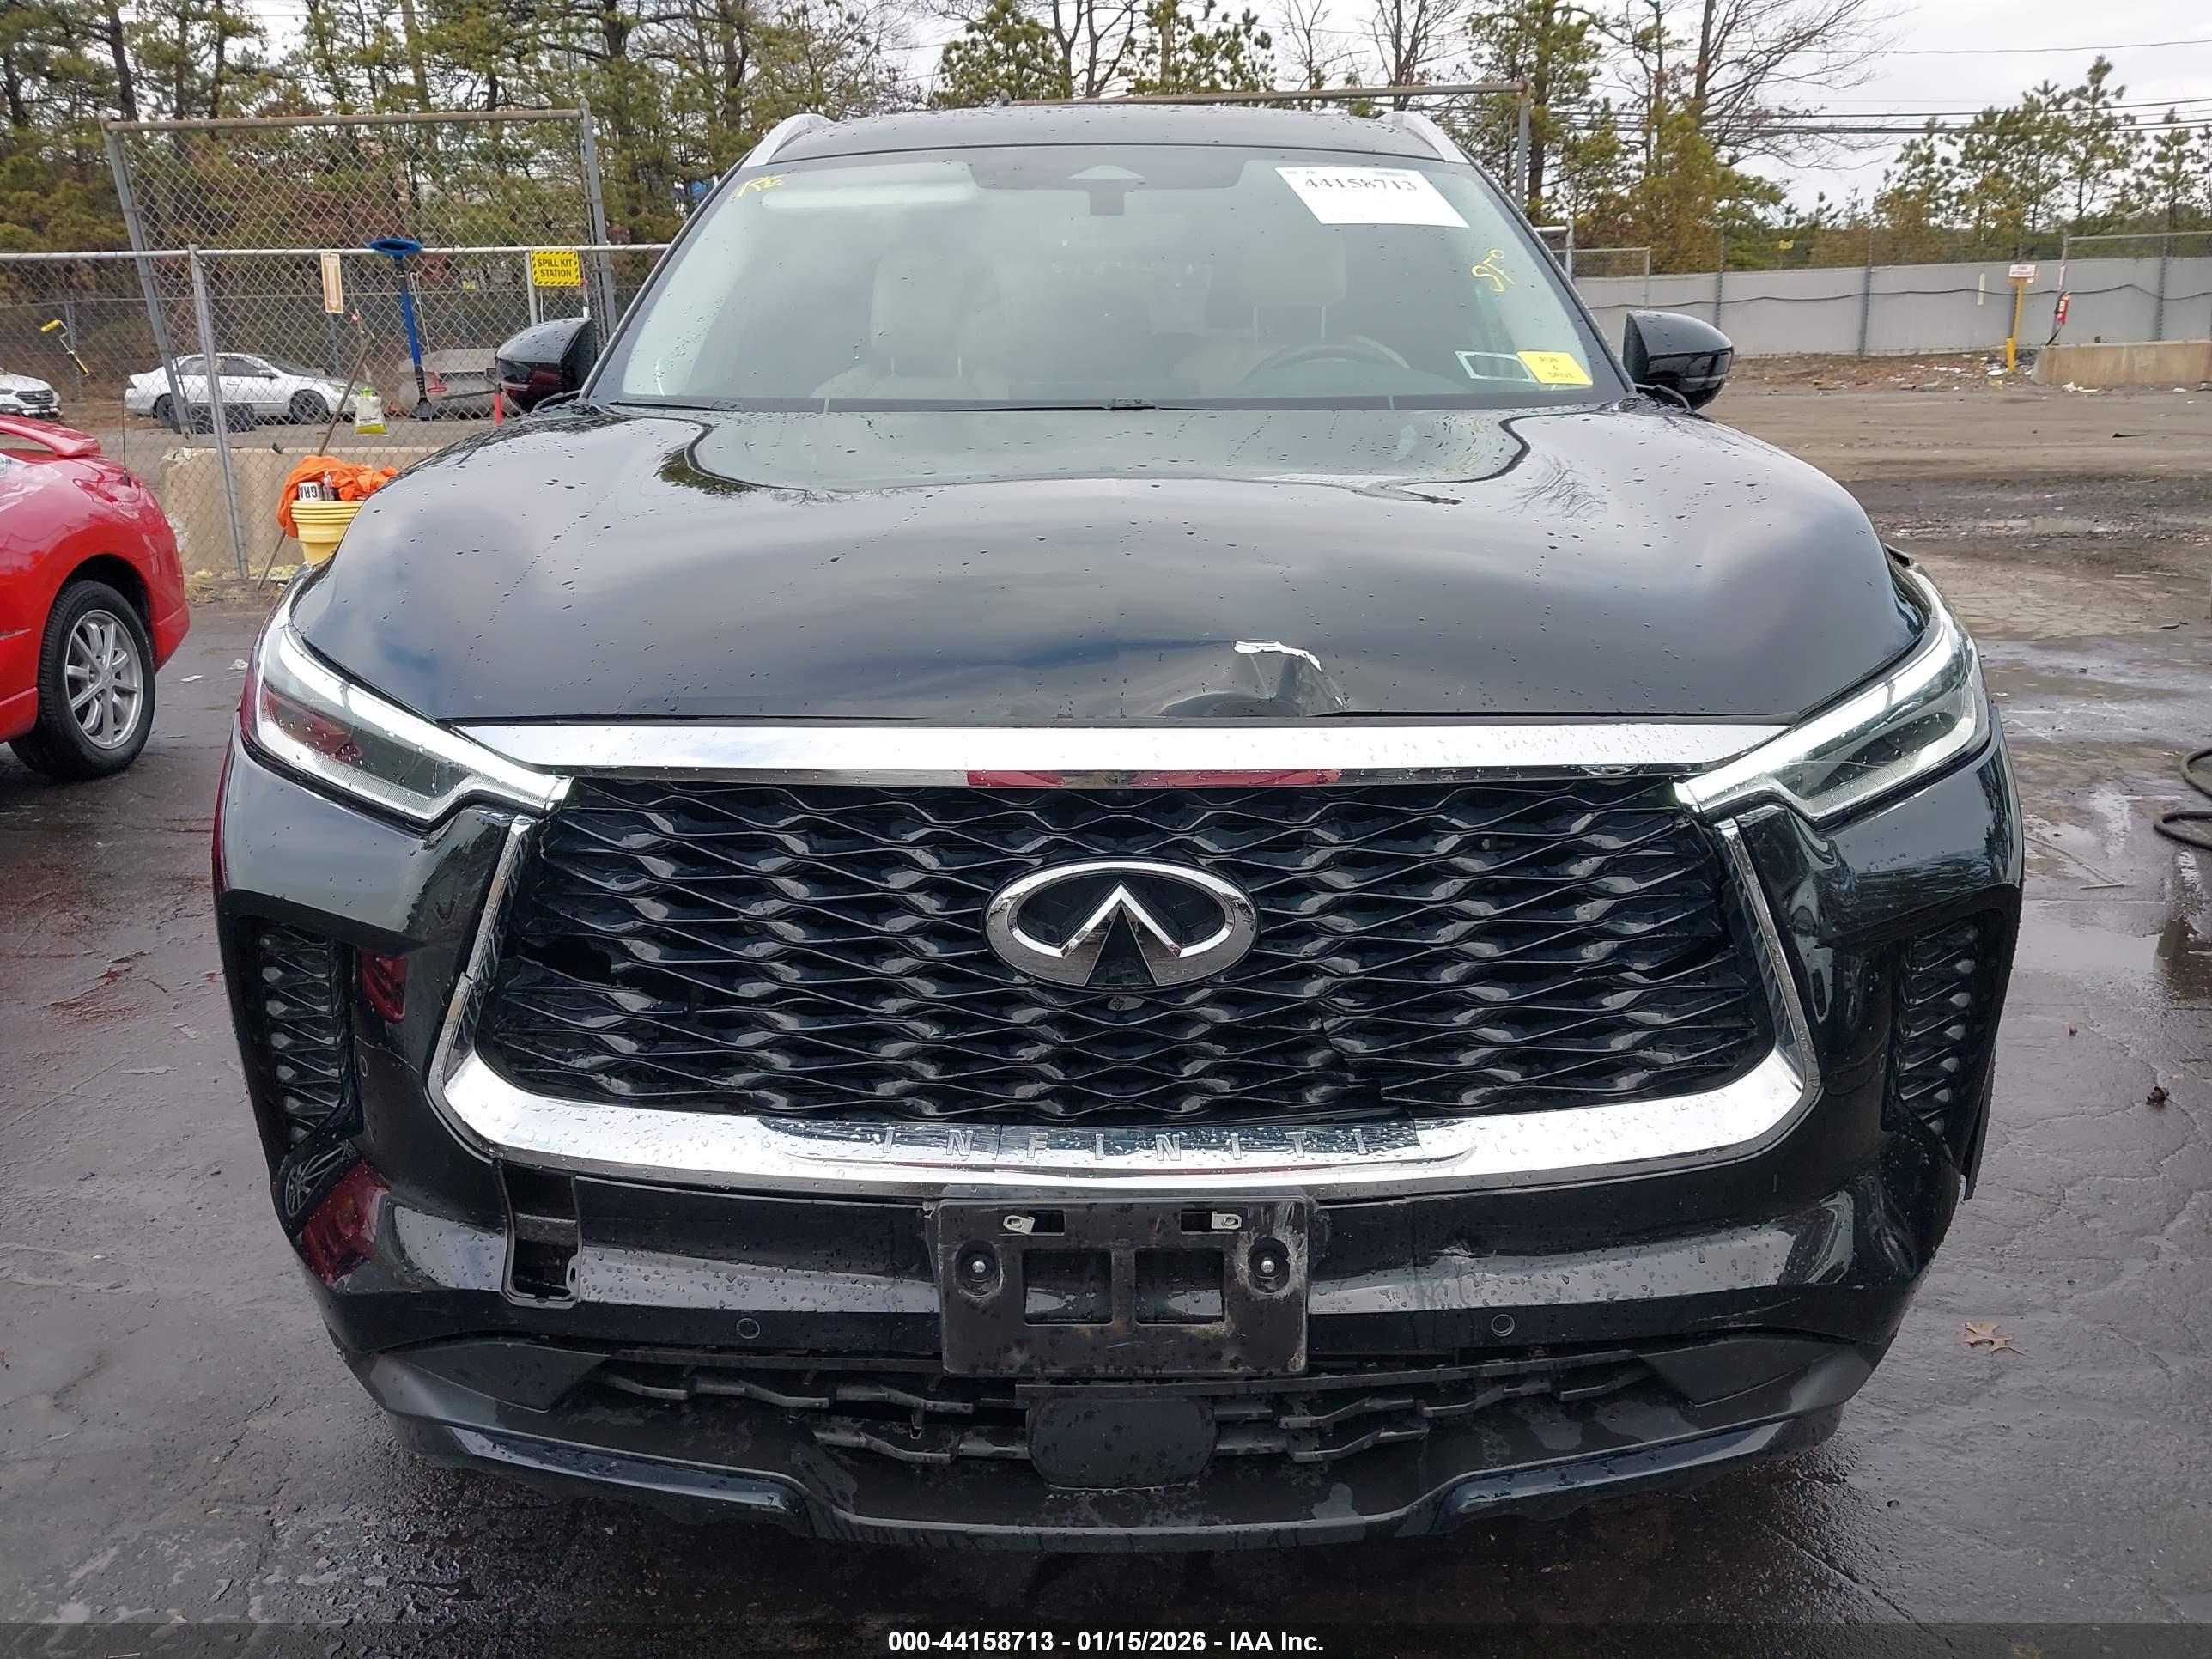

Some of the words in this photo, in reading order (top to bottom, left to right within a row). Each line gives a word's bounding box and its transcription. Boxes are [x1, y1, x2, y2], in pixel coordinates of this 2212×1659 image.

[1305, 178, 1418, 191] 44158713
[537, 258, 560, 267] SPILL
[560, 258, 573, 267] KIT
[540, 269, 573, 277] STATION
[882, 1126, 1370, 1161] INFINITI
